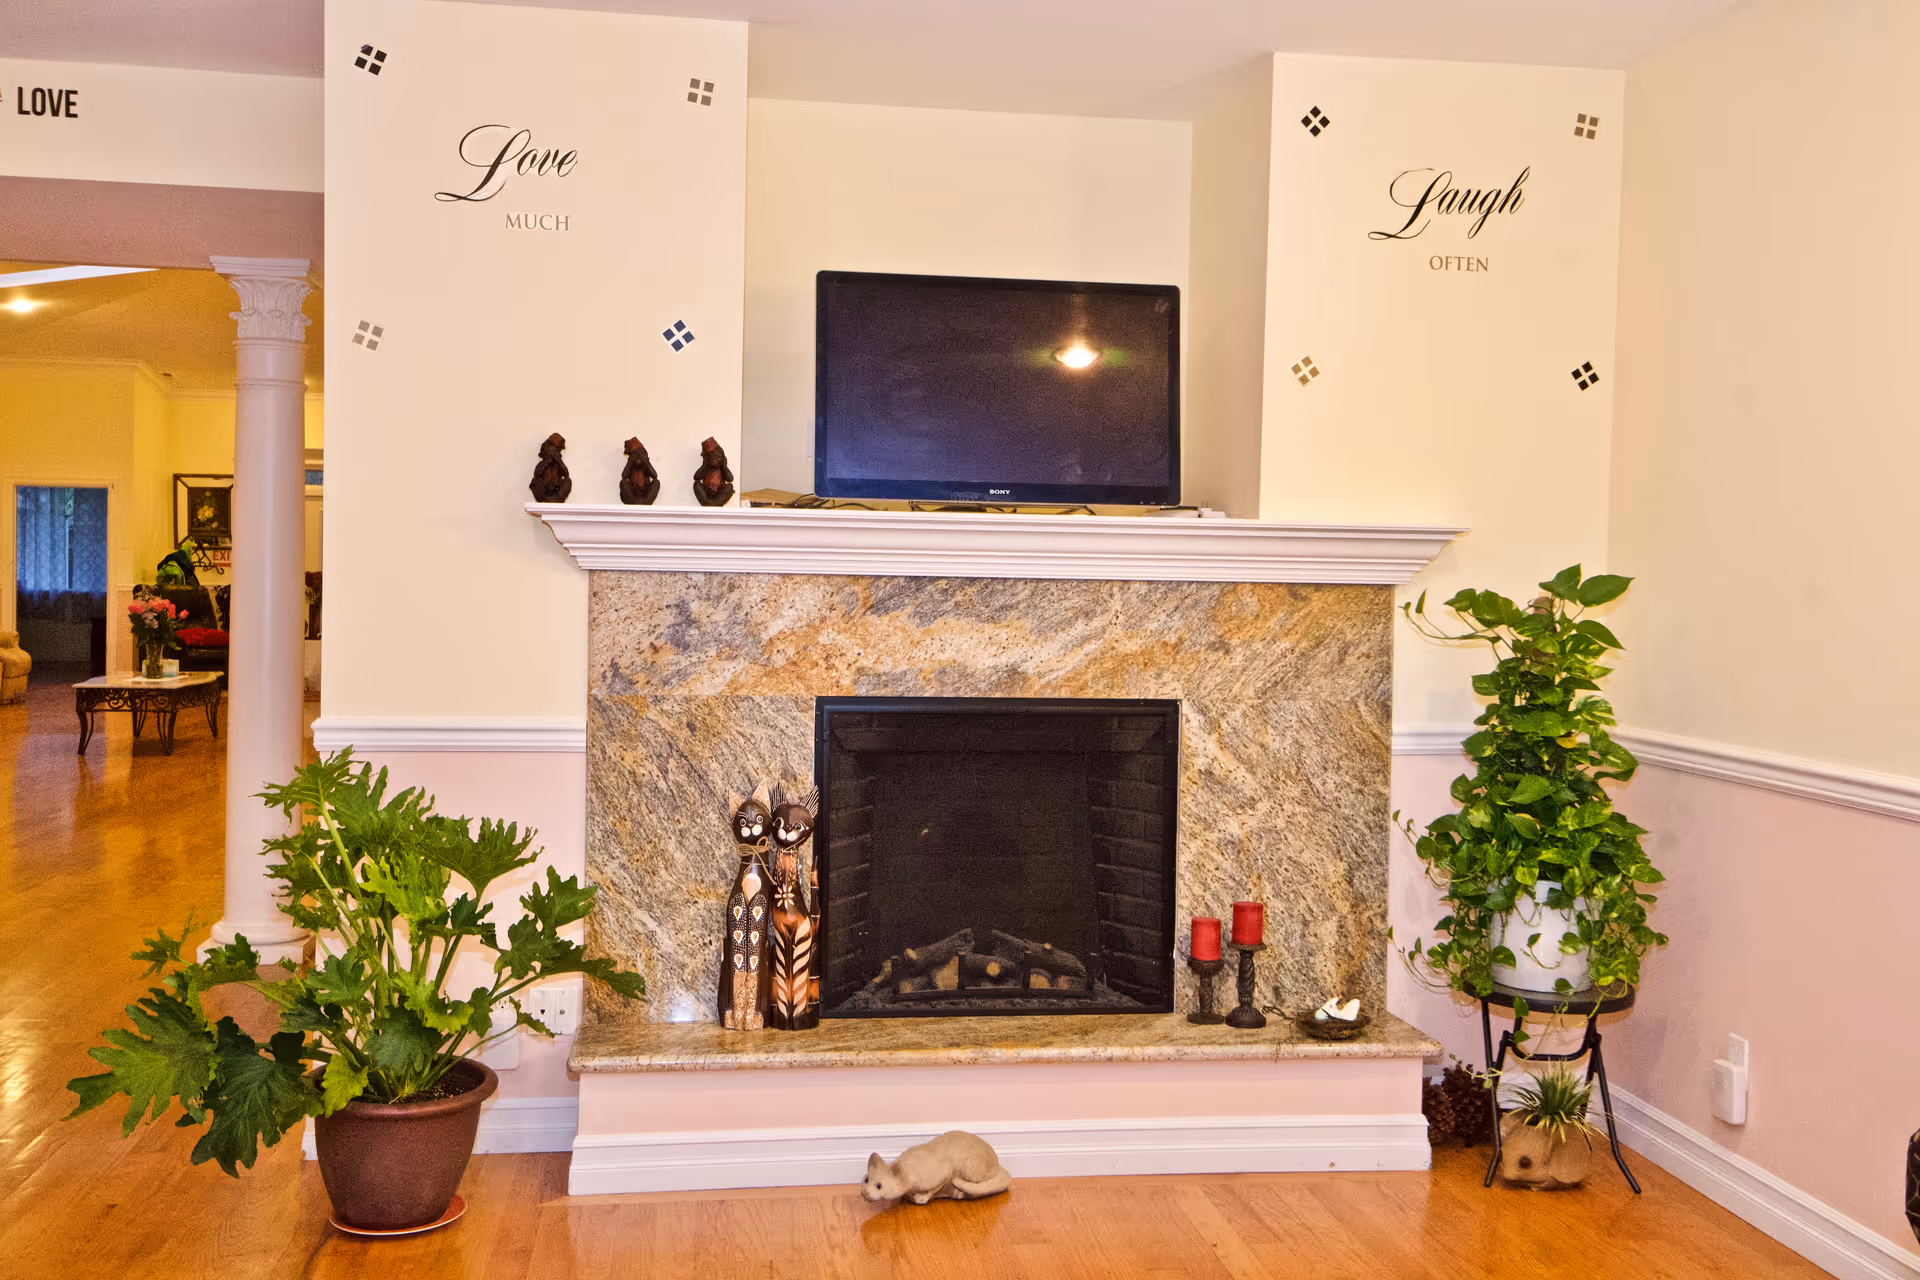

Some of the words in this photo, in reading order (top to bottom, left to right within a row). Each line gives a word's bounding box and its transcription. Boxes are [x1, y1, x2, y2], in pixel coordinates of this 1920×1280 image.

[17, 86, 79, 118] LOVE
[434, 124, 577, 201] Love
[1367, 165, 1531, 240] Laugh
[505, 212, 570, 231] MUCH
[1429, 255, 1489, 272] OFTEN
[213, 550, 231, 561] EXI
